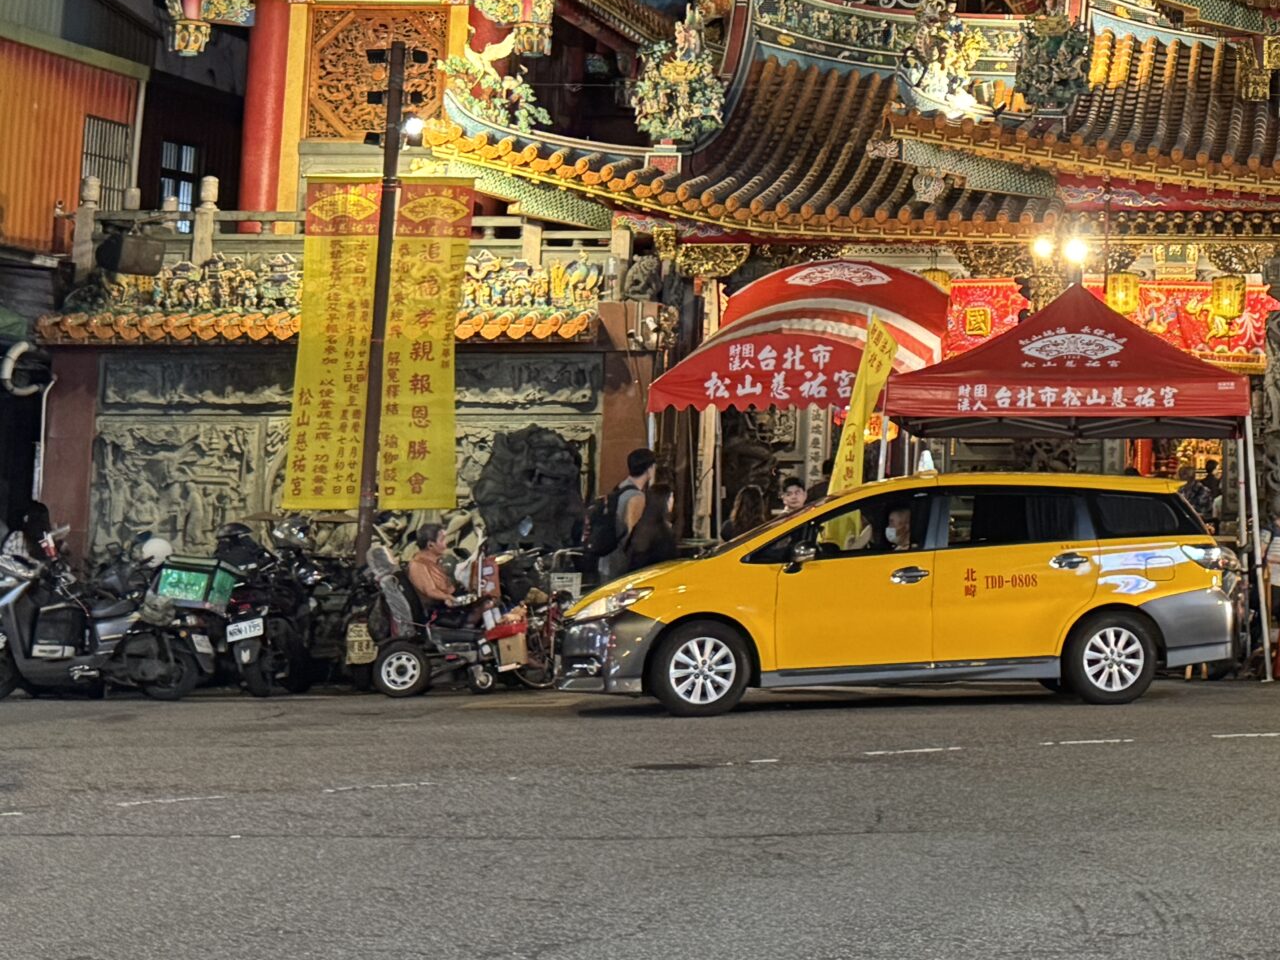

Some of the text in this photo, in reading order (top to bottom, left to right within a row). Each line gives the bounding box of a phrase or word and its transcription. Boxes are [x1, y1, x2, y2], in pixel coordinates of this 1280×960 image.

[310, 223, 376, 235] 松山慈祐宮
[399, 225, 468, 237] 松山慈祐宮
[965, 307, 992, 337] 國
[757, 343, 834, 371] 台北市
[704, 370, 856, 400] 松山慈祐宮
[994, 386, 1179, 408] 台北市松山慈祐宮
[290, 388, 315, 496] 松山慈祐宮
